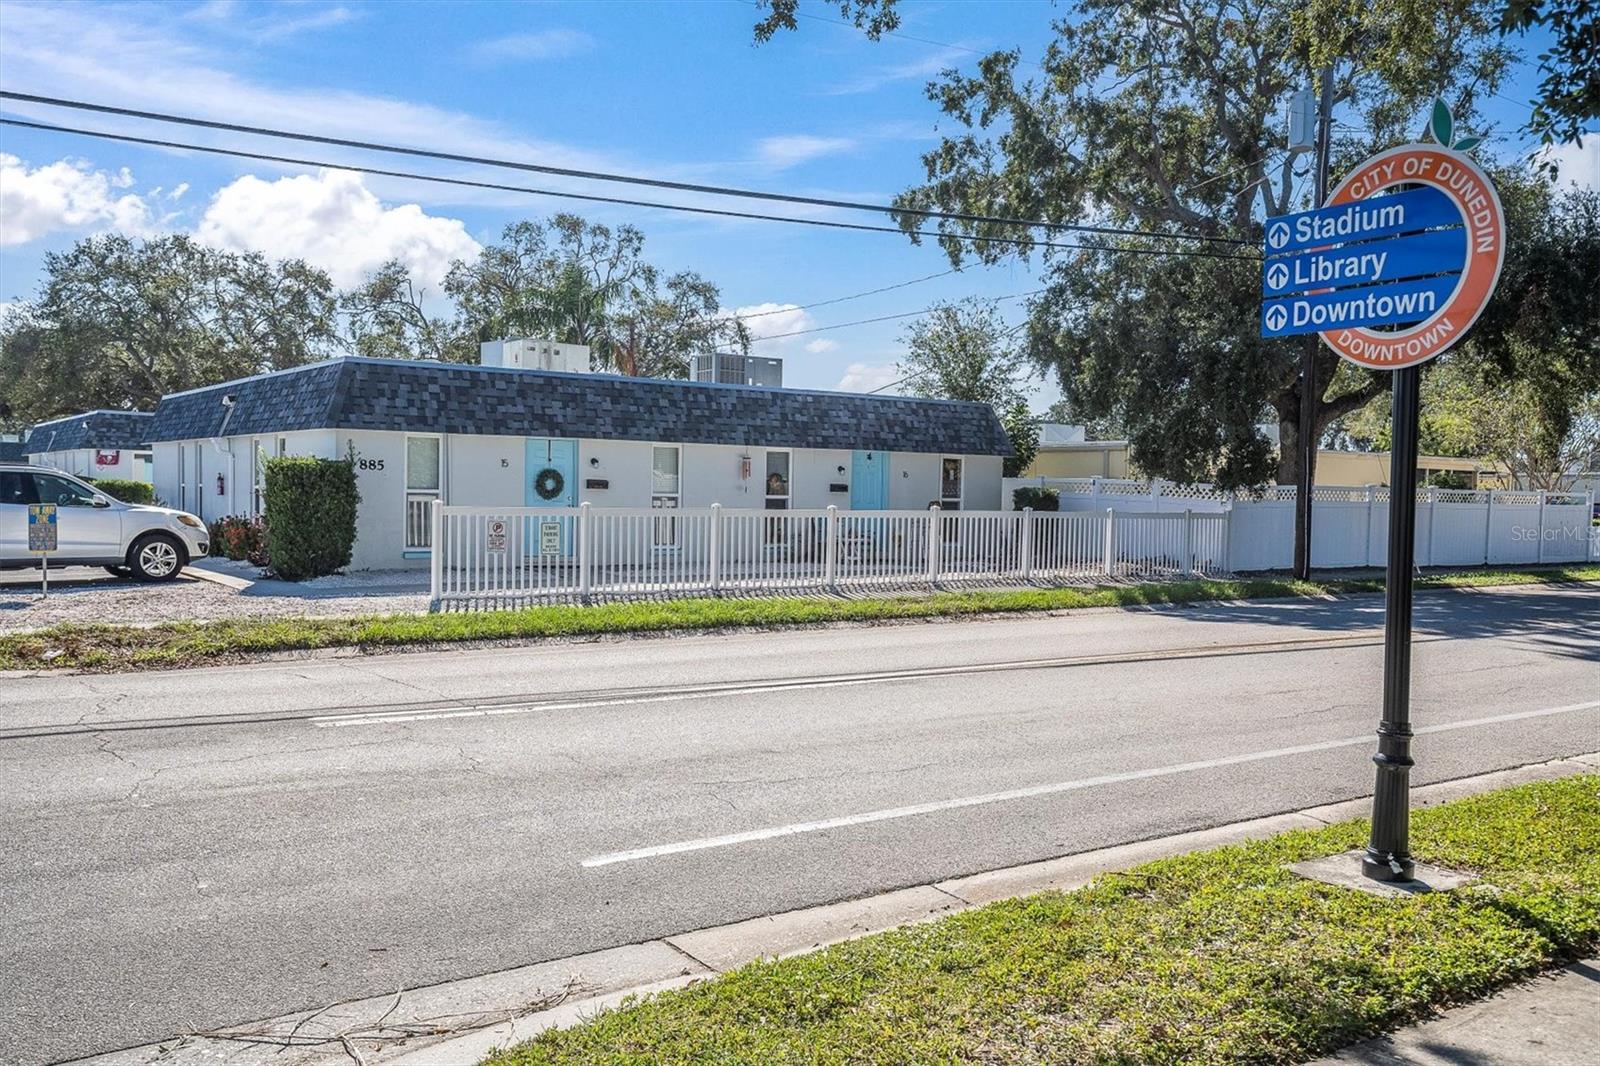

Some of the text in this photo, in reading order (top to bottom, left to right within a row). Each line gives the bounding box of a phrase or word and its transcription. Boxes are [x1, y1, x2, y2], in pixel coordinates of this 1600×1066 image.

[1295, 203, 1404, 243] Stadium
[1350, 157, 1494, 254] CITY OF DUNEDIN
[1294, 252, 1388, 285] Library
[1293, 289, 1436, 327] Downtown
[1337, 317, 1455, 361] DOWNTOWN
[359, 459, 385, 471] 885
